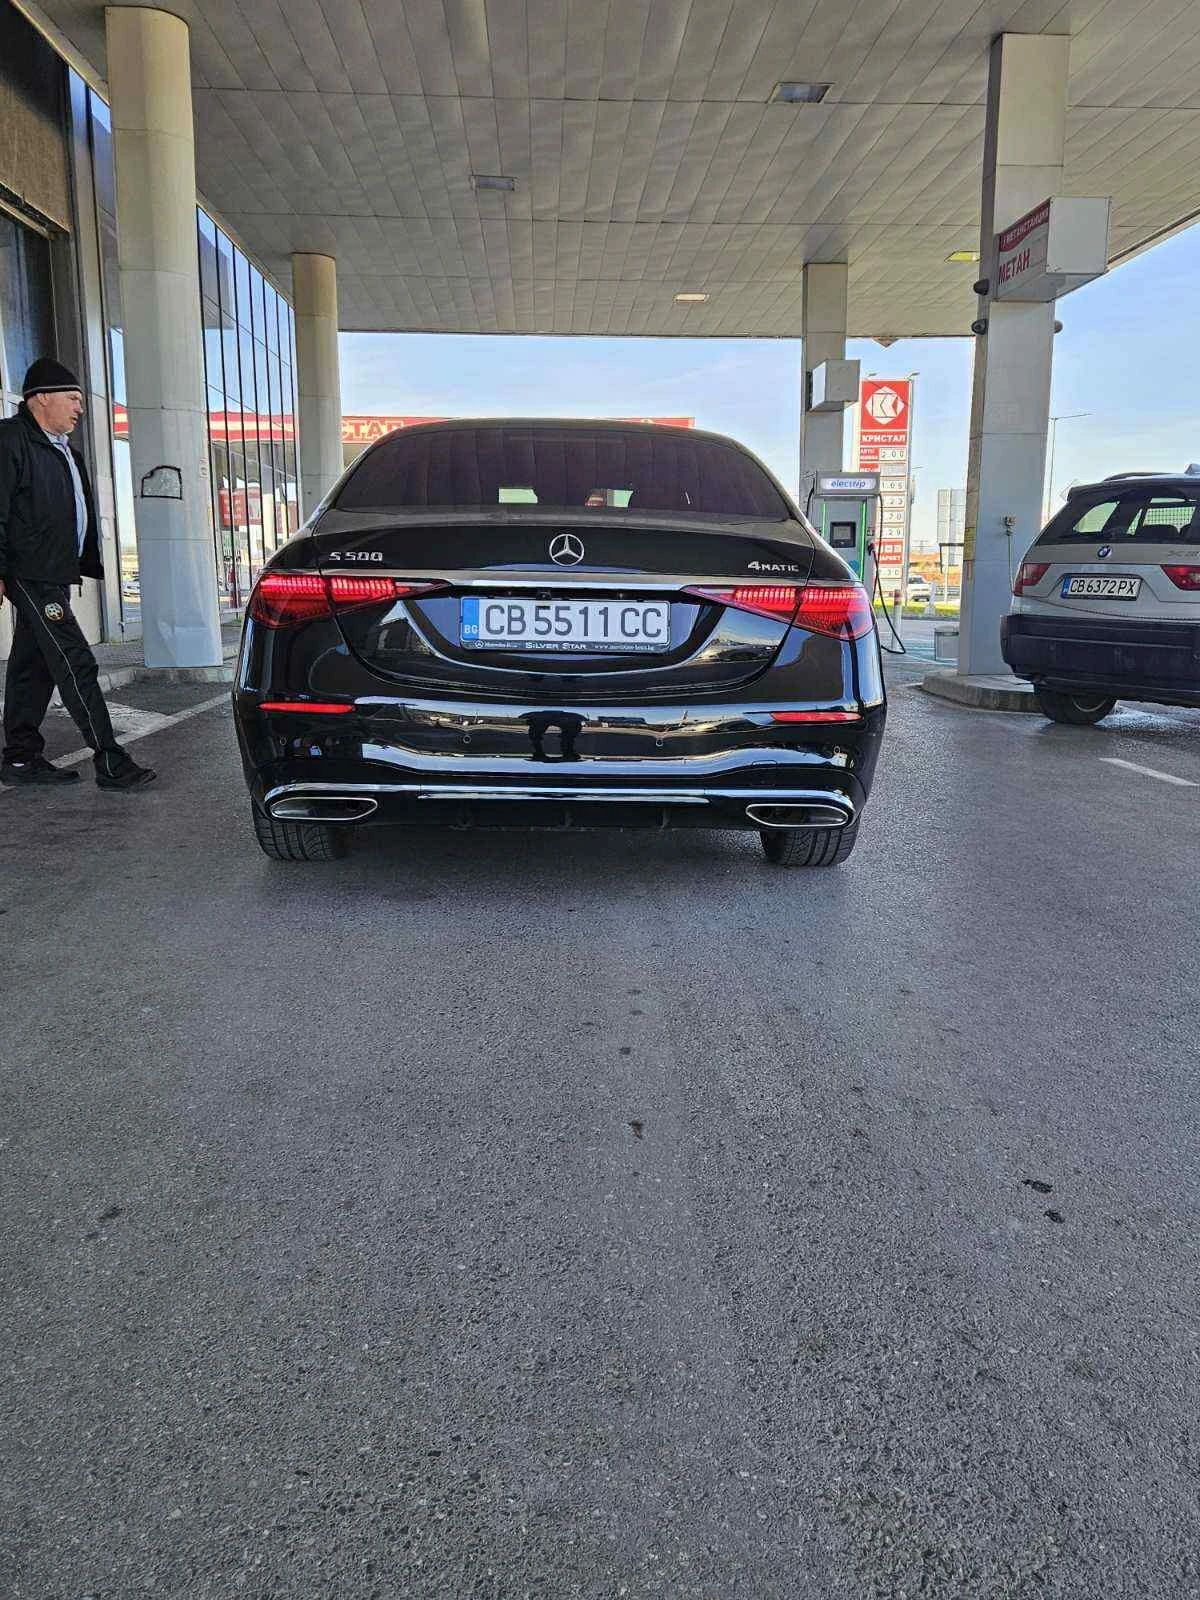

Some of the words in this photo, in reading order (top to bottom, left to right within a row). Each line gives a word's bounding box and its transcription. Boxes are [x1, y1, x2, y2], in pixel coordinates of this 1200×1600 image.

[999, 248, 1031, 285] МЕТАН
[862, 434, 906, 443] КРИСТАЛ
[328, 551, 341, 561] S
[344, 551, 383, 561] 500
[747, 560, 799, 572] 4MATIC
[534, 605, 609, 637] 5511
[464, 624, 479, 634] BG
[562, 642, 587, 650] STAR
